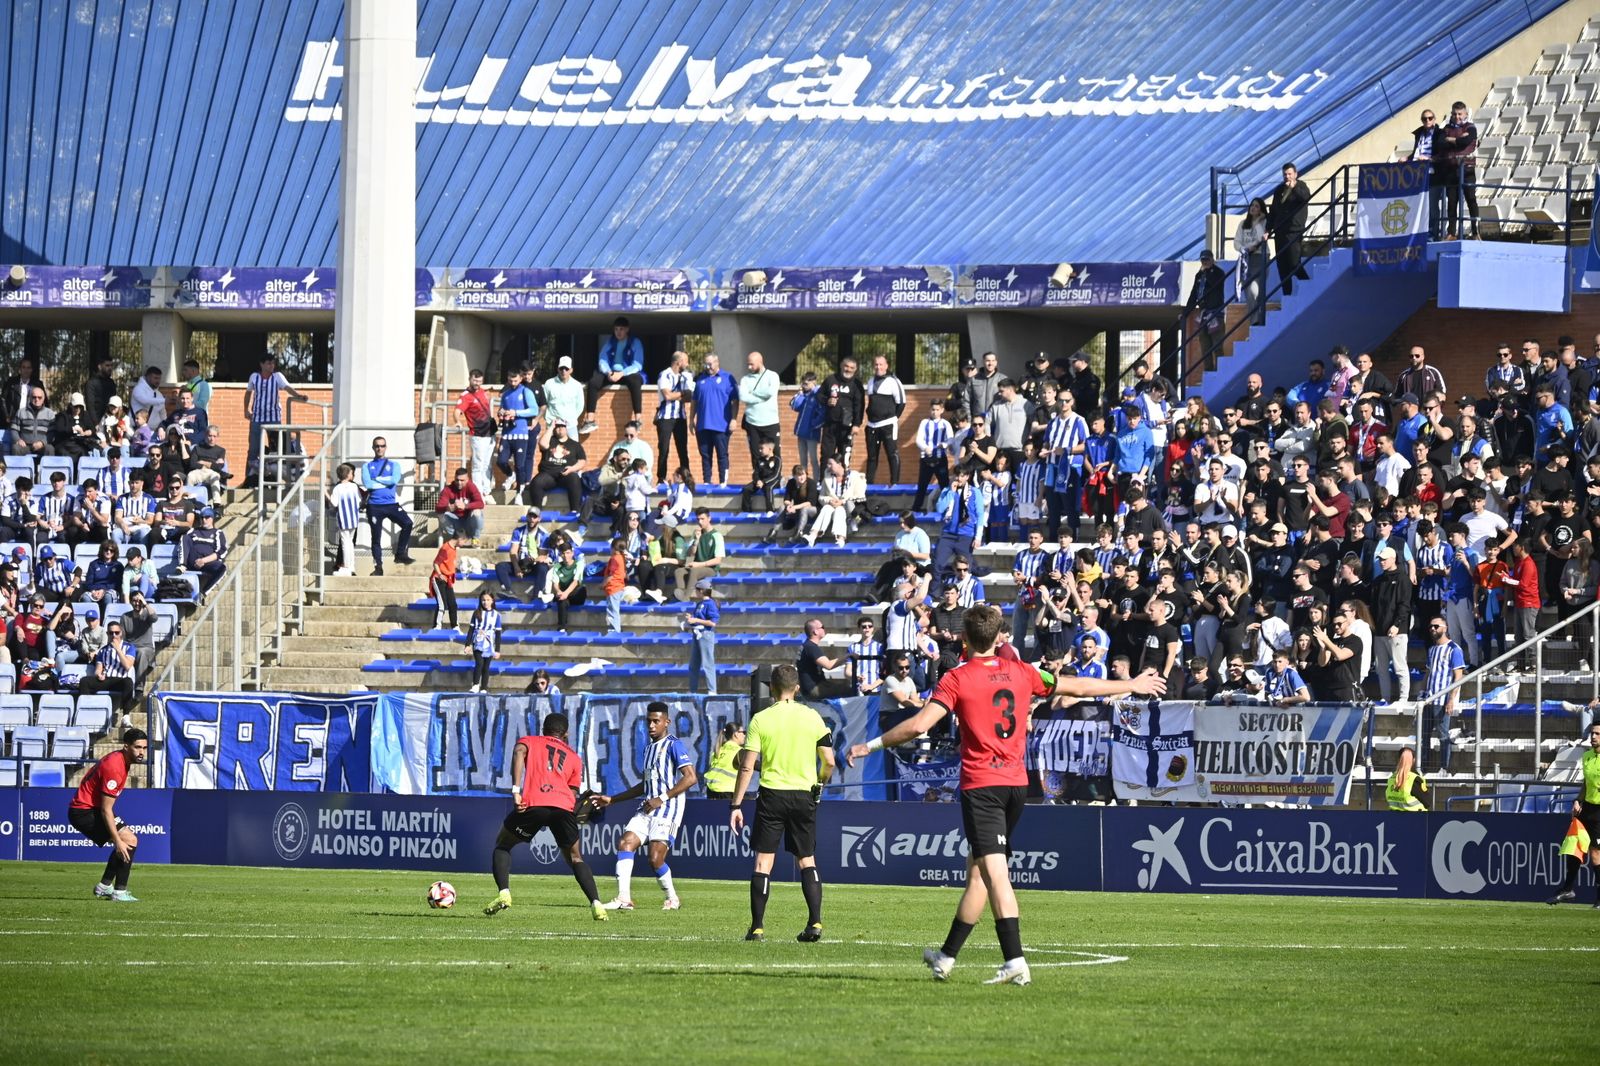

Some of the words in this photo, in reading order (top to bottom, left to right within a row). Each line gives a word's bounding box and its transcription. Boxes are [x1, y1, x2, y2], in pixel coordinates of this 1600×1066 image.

[62, 277, 96, 290] alter
[182, 279, 214, 291] alter
[265, 279, 298, 292] alter
[545, 281, 576, 289] alter
[634, 281, 666, 291] alter
[818, 279, 847, 291] alter
[892, 277, 920, 290] alter
[975, 277, 1002, 289] alter
[1121, 274, 1148, 287] alter
[63, 290, 121, 301] enersun
[193, 291, 239, 302] nersun
[265, 291, 322, 303] enersun
[544, 291, 599, 304] enersun
[633, 293, 689, 305] enersun
[737, 292, 788, 304] enersun
[817, 291, 868, 303] enersun
[891, 290, 943, 302] enersun
[975, 289, 1020, 301] enersun
[1046, 288, 1092, 300] enersun
[1121, 287, 1166, 299] enersun
[992, 688, 1016, 739] 3
[1239, 713, 1304, 732] SECTOR
[545, 743, 567, 773] 11
[1194, 735, 1354, 775] HELICÓSTERO
[29, 811, 50, 820] 1889
[318, 808, 376, 831] HOTEL
[382, 807, 451, 833] MARTÍN
[29, 824, 66, 834] DECANO
[29, 839, 47, 847] BIEN
[48, 839, 60, 847] DE
[61, 837, 94, 847] INTERÉS
[311, 834, 383, 857] ALONSO
[389, 834, 457, 859] PINZÓN
[694, 825, 738, 857] CINTA
[1200, 817, 1399, 876] CaixaBank
[1488, 841, 1596, 887] COPIADR
[920, 869, 949, 881] CREA
[952, 870, 967, 882] TU
